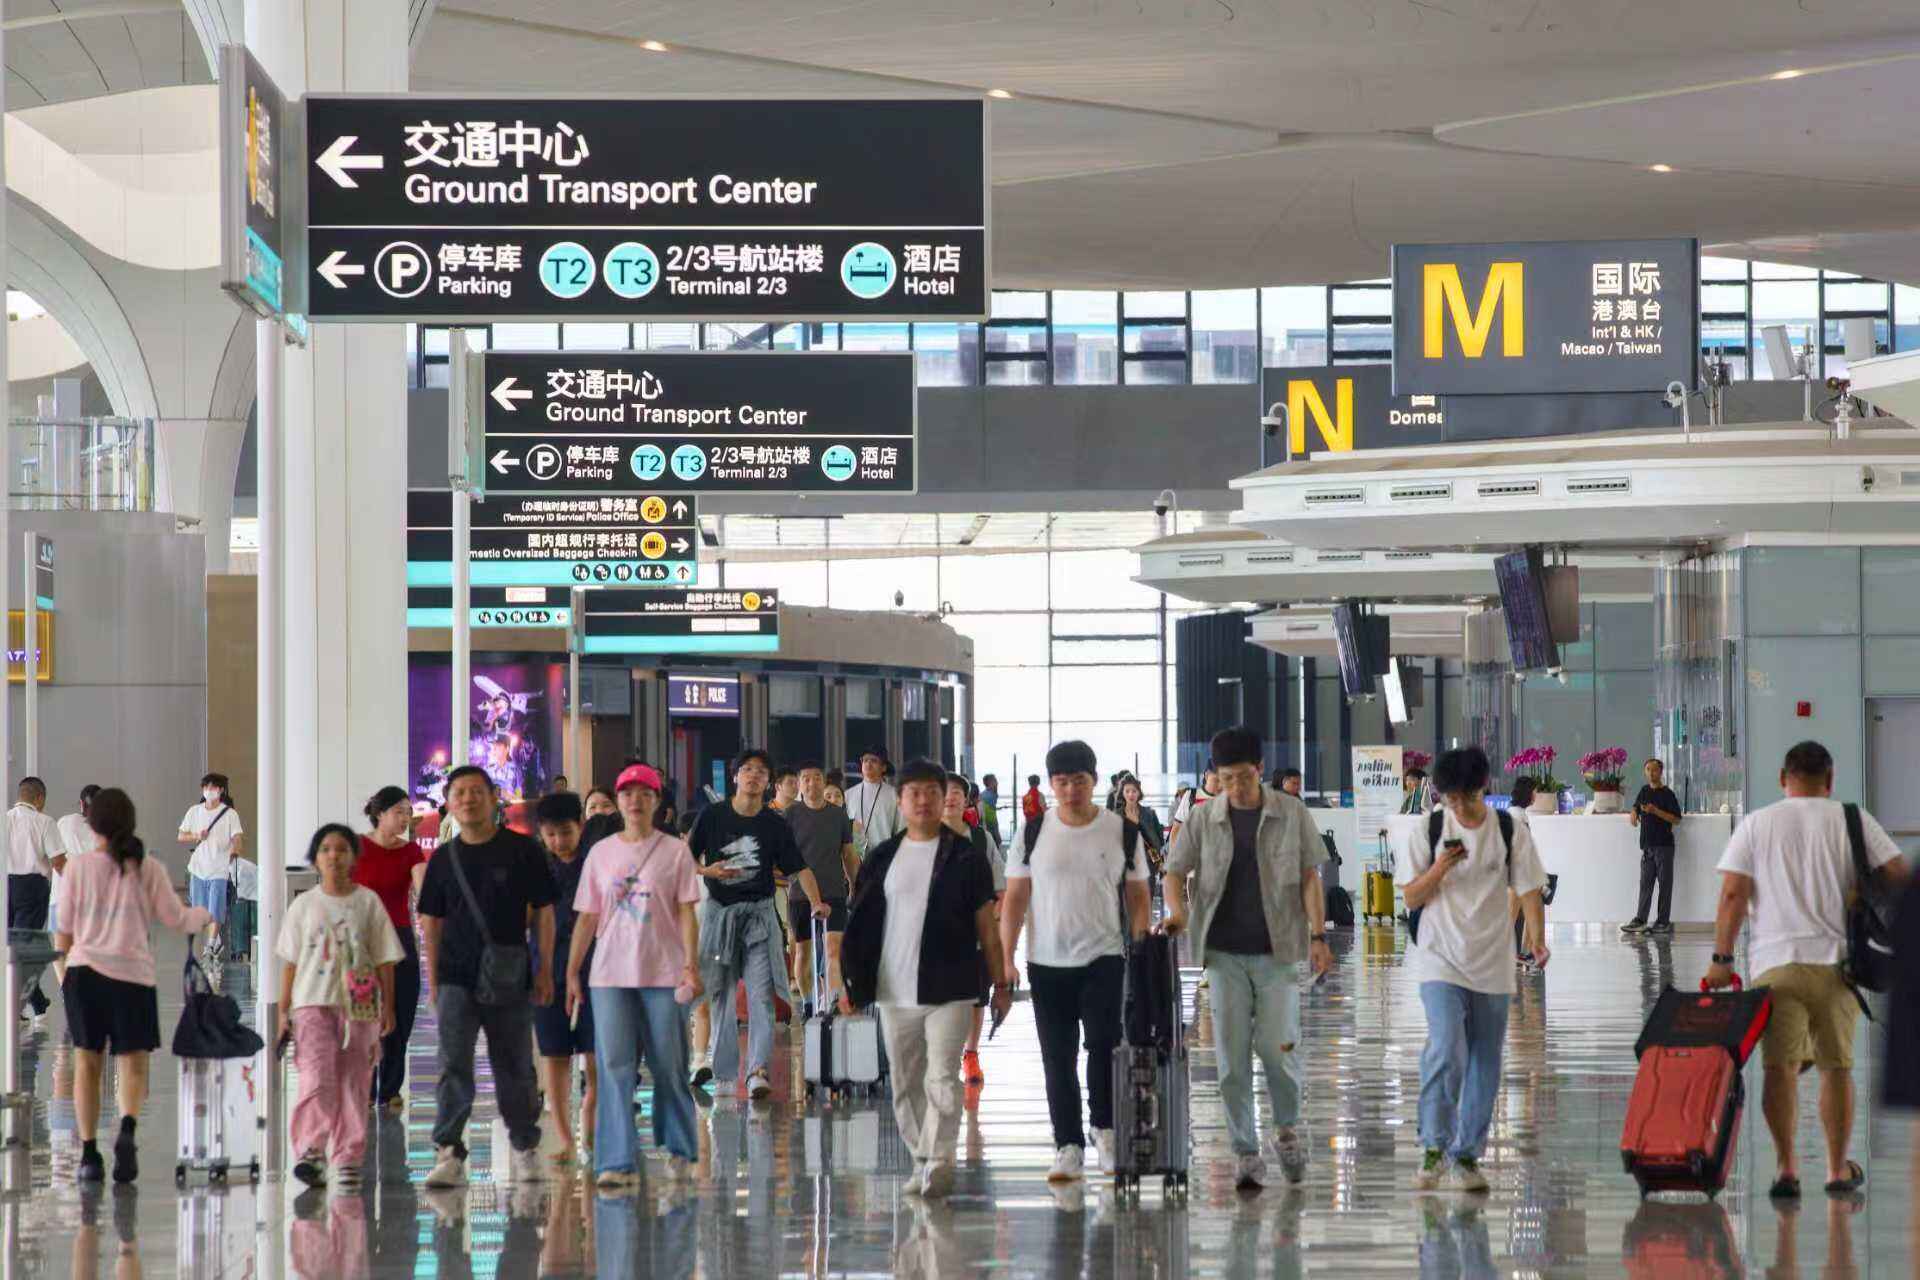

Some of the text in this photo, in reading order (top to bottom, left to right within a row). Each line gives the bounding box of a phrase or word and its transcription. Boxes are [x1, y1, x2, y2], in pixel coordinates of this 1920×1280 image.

[403, 119, 590, 169] 交通中心
[404, 173, 818, 211] Ground Transport Center
[437, 243, 522, 273] 停车库
[666, 243, 824, 273] 2/3号航站楼
[903, 243, 961, 273] 酒店
[391, 252, 420, 289] P
[546, 258, 588, 285] T2
[611, 259, 653, 286] T3
[1592, 262, 1662, 297] 国际
[438, 275, 512, 299] Parking
[665, 275, 788, 295] Terminal 2/3
[903, 276, 955, 295] Hotel
[1423, 261, 1524, 359] M
[1591, 298, 1662, 322] 港澳台
[1591, 324, 1663, 339] Int'l & HK /
[1561, 341, 1662, 356] Macao / Taiwan
[545, 368, 664, 401] 交通中心
[546, 401, 808, 428] Ground Transport Center
[1287, 377, 1354, 455] N
[536, 451, 555, 474] P
[566, 444, 620, 465] 停车库
[635, 454, 662, 472] T2
[675, 455, 702, 473] T3
[710, 445, 811, 465] 2/3号航站楼
[860, 446, 898, 466] 酒店
[566, 465, 613, 481] Parking
[710, 465, 788, 479] Terminal 2/3
[860, 465, 897, 480] Hotel
[586, 511, 612, 522] Police
[612, 511, 639, 522] Office
[503, 547, 550, 559] Oversized
[552, 548, 595, 561] Baggage
[685, 602, 713, 612] Baggage
[708, 687, 727, 703] POLICE
